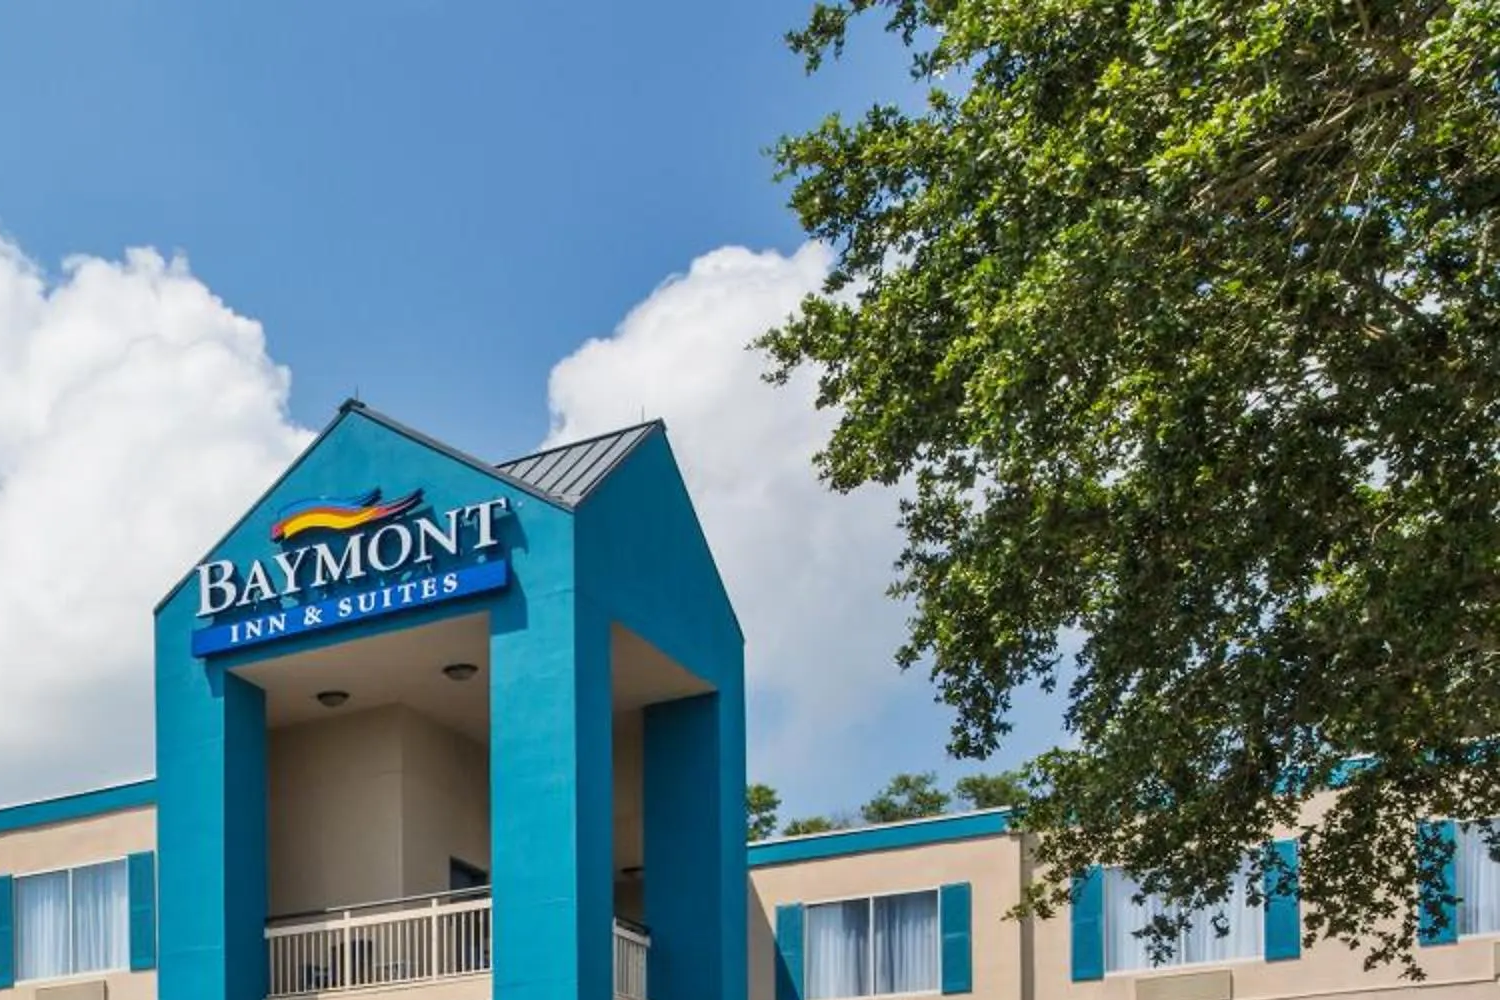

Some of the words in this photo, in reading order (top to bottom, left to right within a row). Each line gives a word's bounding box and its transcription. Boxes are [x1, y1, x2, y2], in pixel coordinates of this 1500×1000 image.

[195, 497, 507, 616] BAYMONT
[231, 613, 287, 643] INN
[303, 604, 324, 626] &
[339, 573, 459, 617] SUITES
